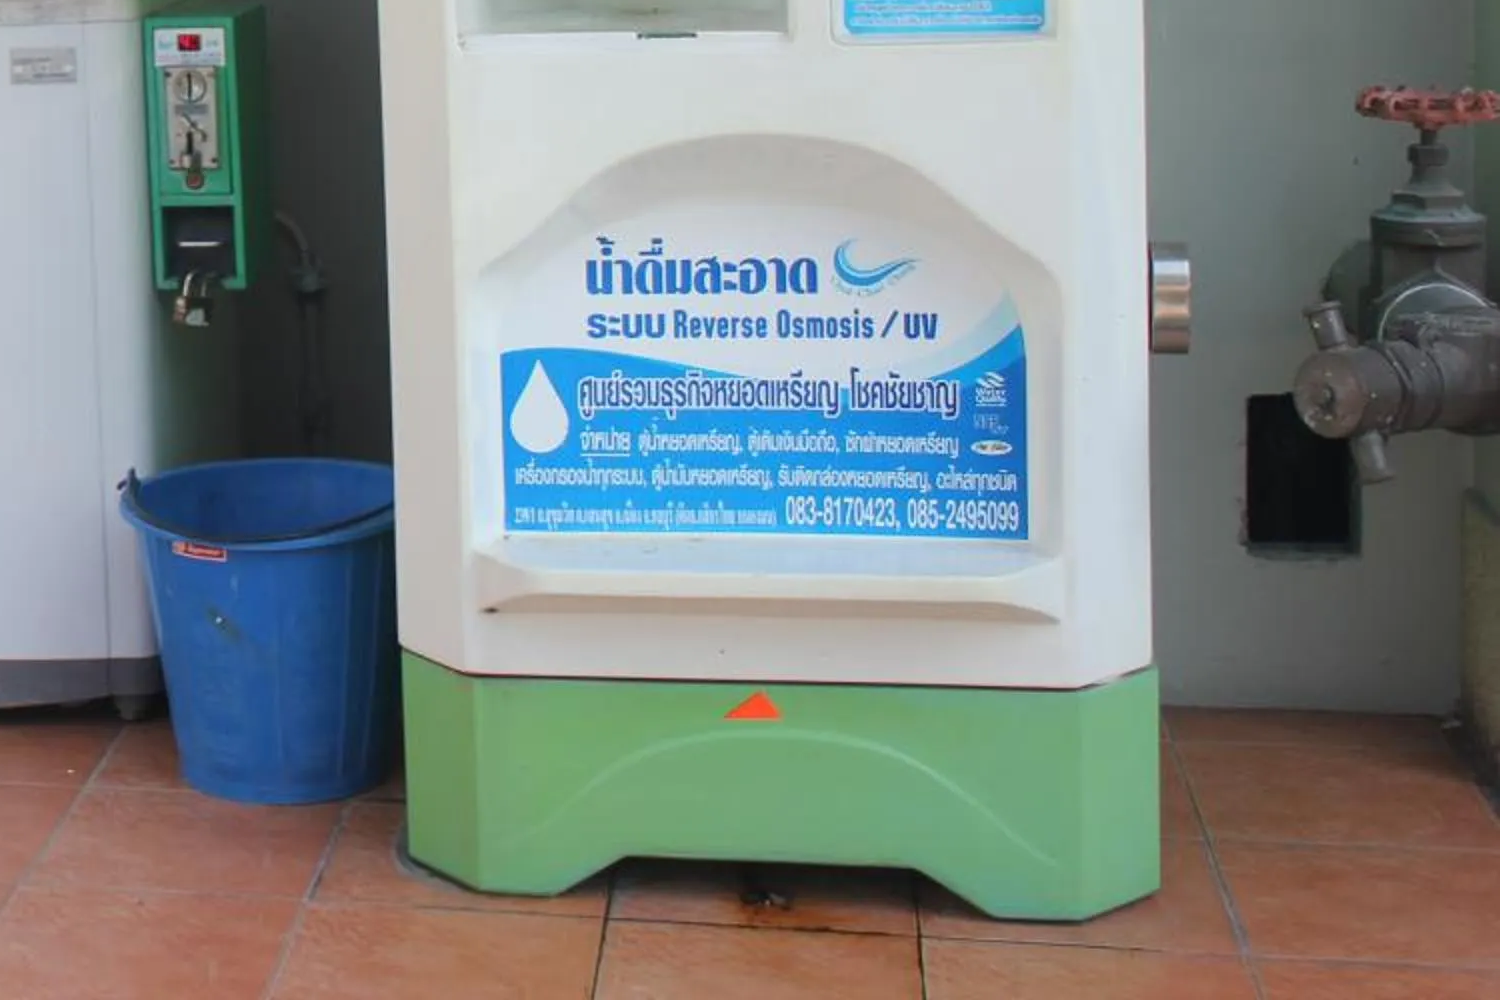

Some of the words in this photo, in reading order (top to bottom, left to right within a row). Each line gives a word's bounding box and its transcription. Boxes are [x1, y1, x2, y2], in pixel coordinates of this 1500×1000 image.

[585, 237, 819, 295] น้ำดื่มสะอาด
[586, 311, 666, 340] ระบบ
[673, 309, 768, 340] Reverse
[777, 308, 875, 340] Osmosis
[903, 311, 939, 340] UV
[578, 369, 840, 418] ศูนย์รวมธุรกิจหยอดเหรียญ
[849, 366, 959, 419] โชคชัยชาญ
[786, 496, 901, 531] 083-8170423,
[907, 500, 1020, 532] 085-2495099
